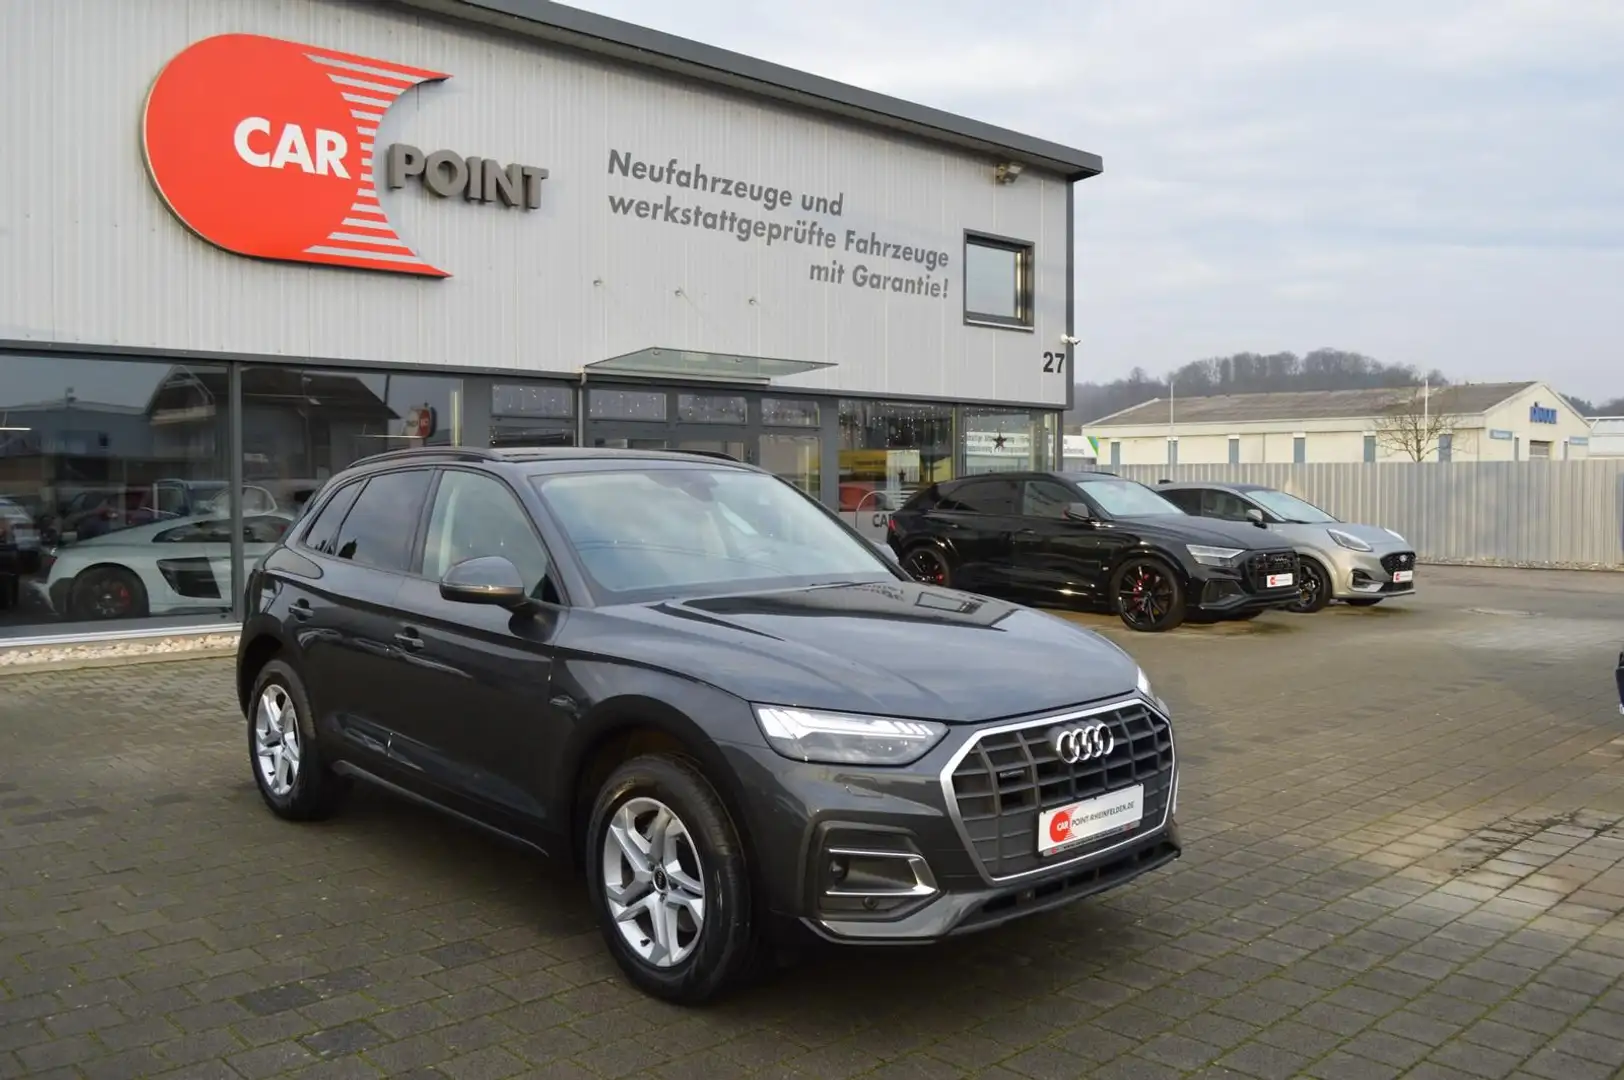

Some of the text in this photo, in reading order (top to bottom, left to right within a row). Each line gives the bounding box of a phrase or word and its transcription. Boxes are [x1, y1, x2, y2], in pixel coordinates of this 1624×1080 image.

[233, 116, 351, 180] CAR
[387, 142, 549, 211] POINT
[608, 149, 844, 216] Neufahrzeuge und
[608, 195, 949, 271] werkstattgeprüfte Fahrzeuge
[809, 261, 949, 299] mit Garantie!
[1043, 351, 1065, 373] 27
[1056, 820, 1069, 831] CAR
